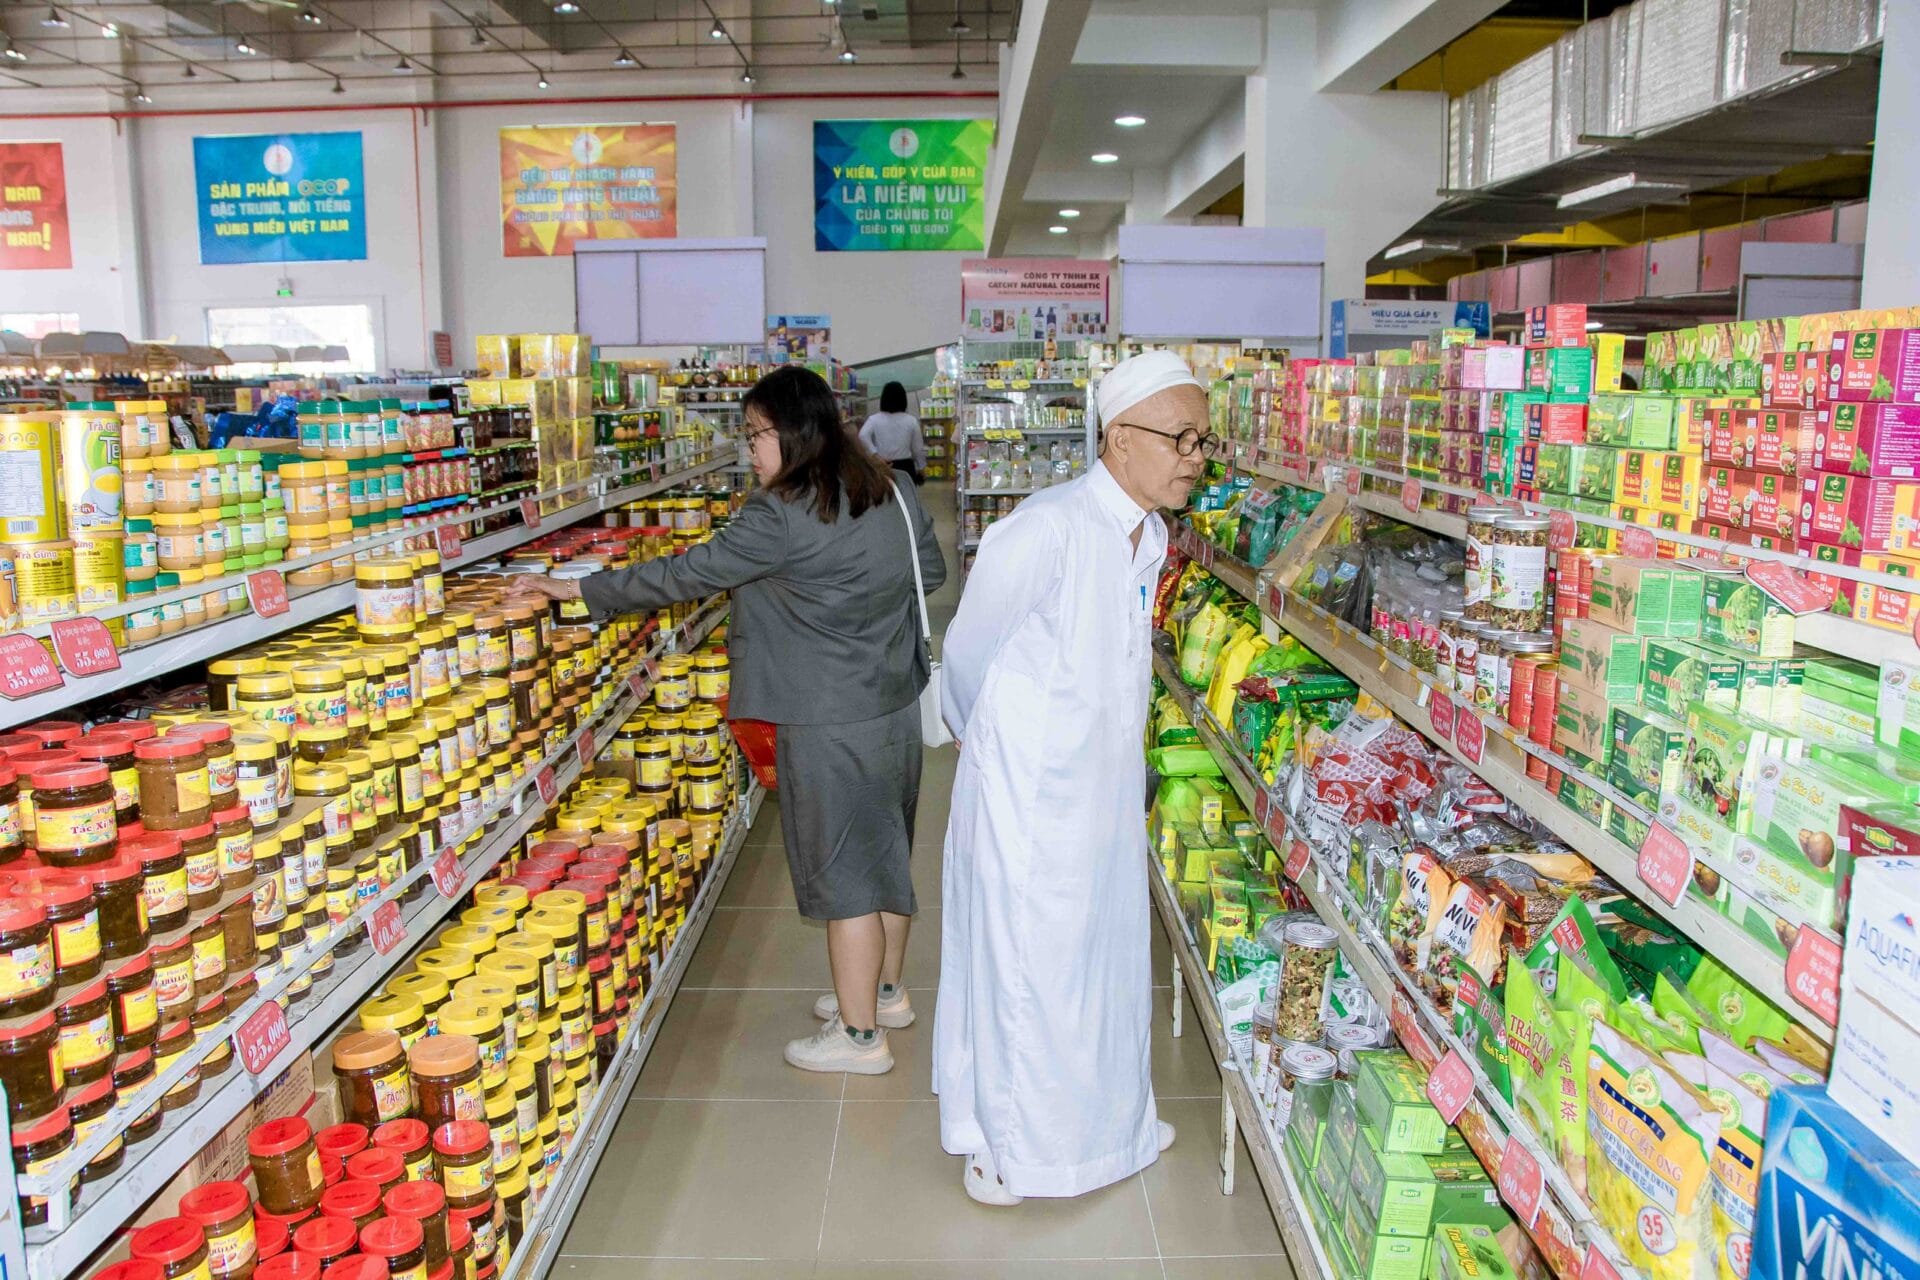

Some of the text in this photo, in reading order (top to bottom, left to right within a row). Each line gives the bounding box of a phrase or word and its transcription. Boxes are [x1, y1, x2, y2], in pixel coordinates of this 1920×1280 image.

[210, 180, 241, 199] SẢN
[246, 177, 290, 197] PHẨM
[842, 182, 868, 204] LÀ
[934, 185, 967, 203] VUI
[320, 220, 349, 232] NAM
[74, 648, 110, 668] 55.000
[6, 664, 49, 690] 55.000
[1510, 1014, 1532, 1043] TRÀ
[247, 1016, 287, 1068] 25.000
[1602, 1083, 1663, 1137] INSTANT
[1617, 1116, 1640, 1142] CÚC
[1656, 1154, 1683, 1181] ONG
[1650, 1172, 1674, 1198] DRINK
[1642, 1213, 1664, 1238] 35
